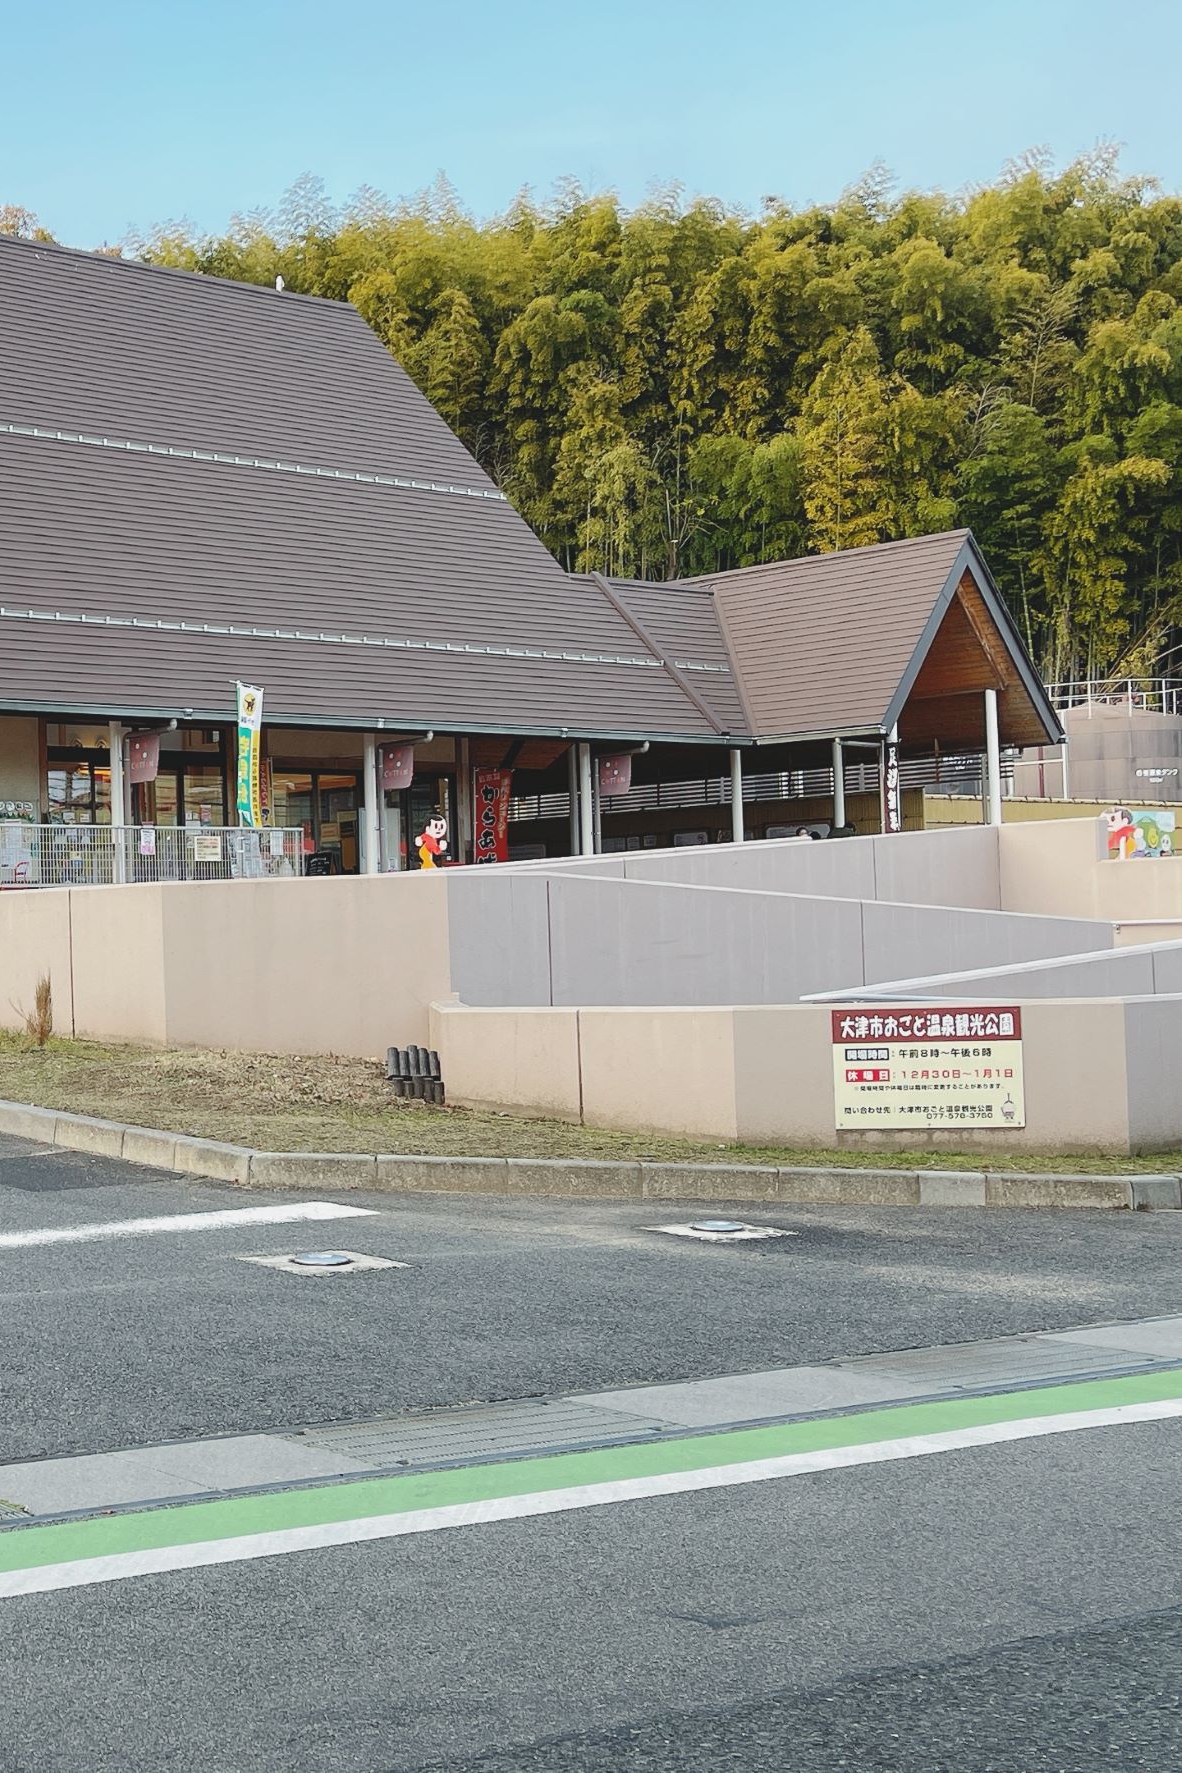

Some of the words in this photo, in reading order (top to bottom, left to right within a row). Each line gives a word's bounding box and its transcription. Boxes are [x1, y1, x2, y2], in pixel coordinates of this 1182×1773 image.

[840, 1012, 1014, 1039] 大津市おごと温泉観光公園
